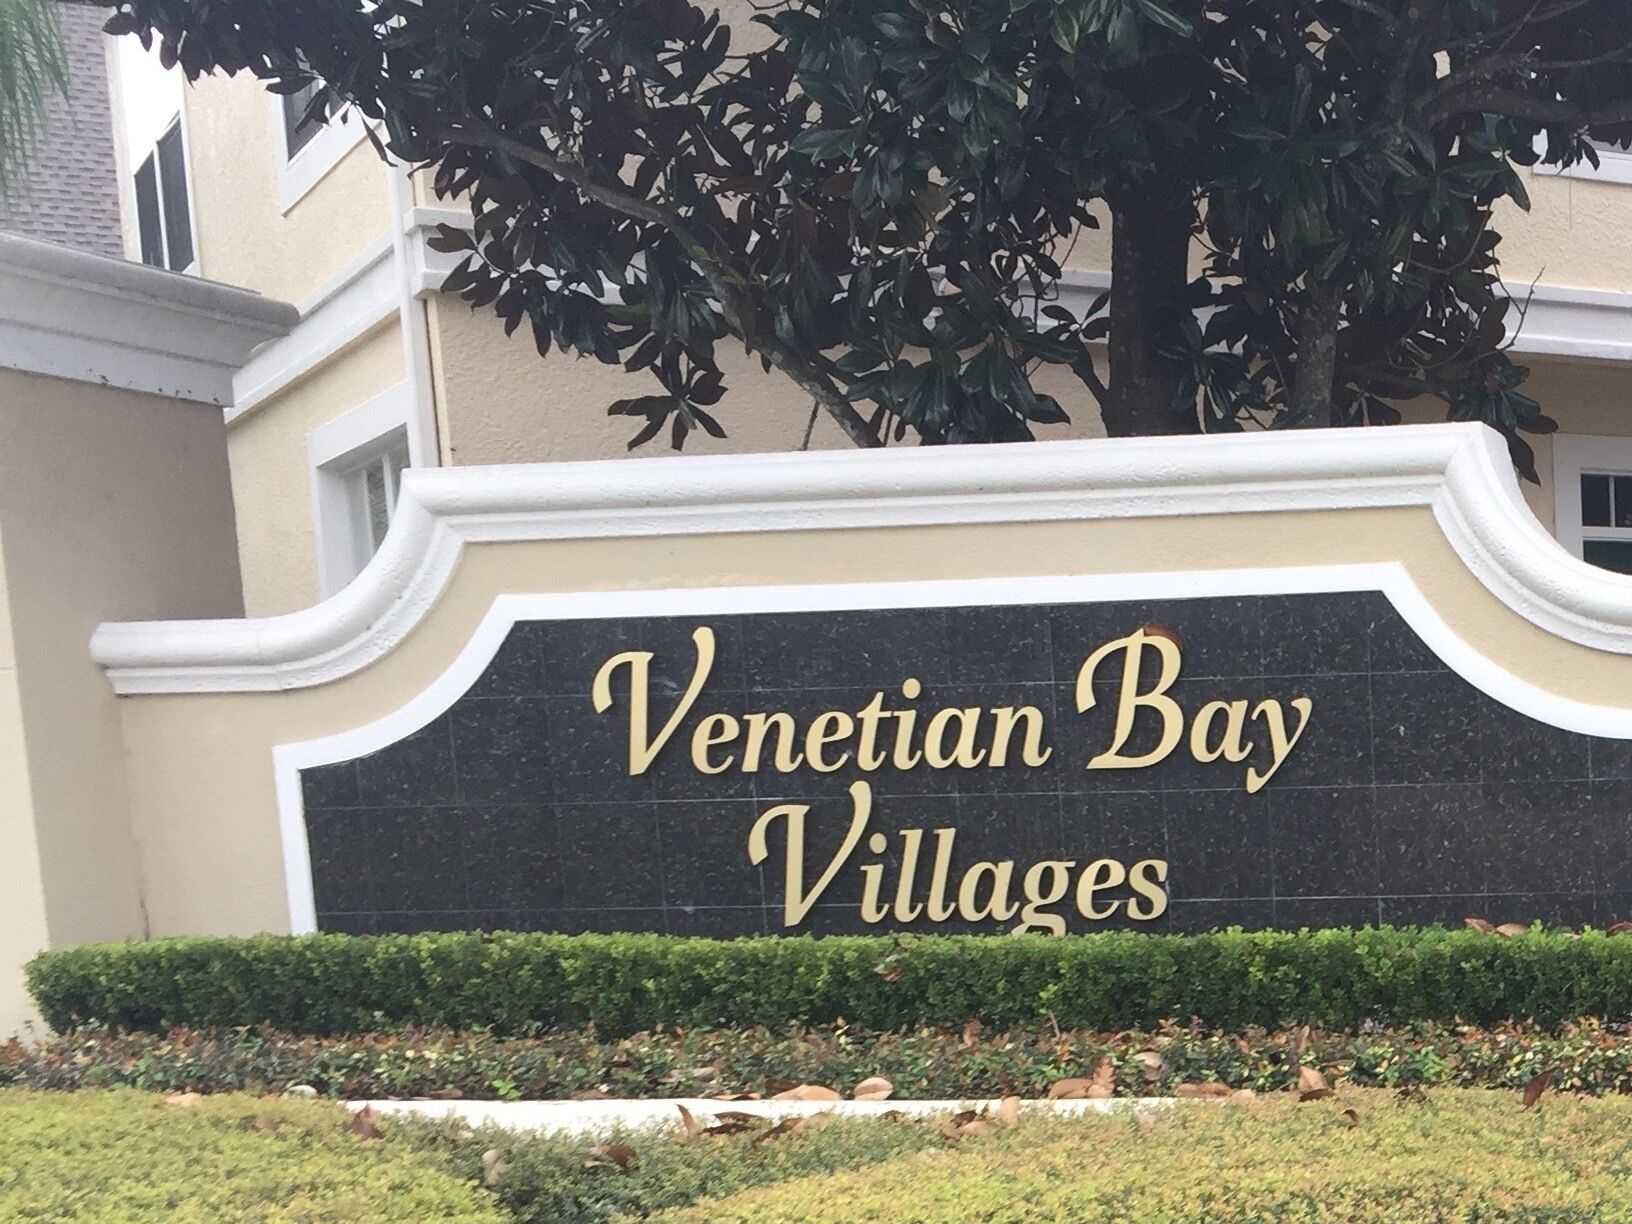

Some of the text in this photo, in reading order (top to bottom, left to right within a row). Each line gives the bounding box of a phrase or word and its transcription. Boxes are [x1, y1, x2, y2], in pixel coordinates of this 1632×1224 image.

[591, 626, 1312, 793] Venetian Bay
[747, 780, 1169, 936] Villages
